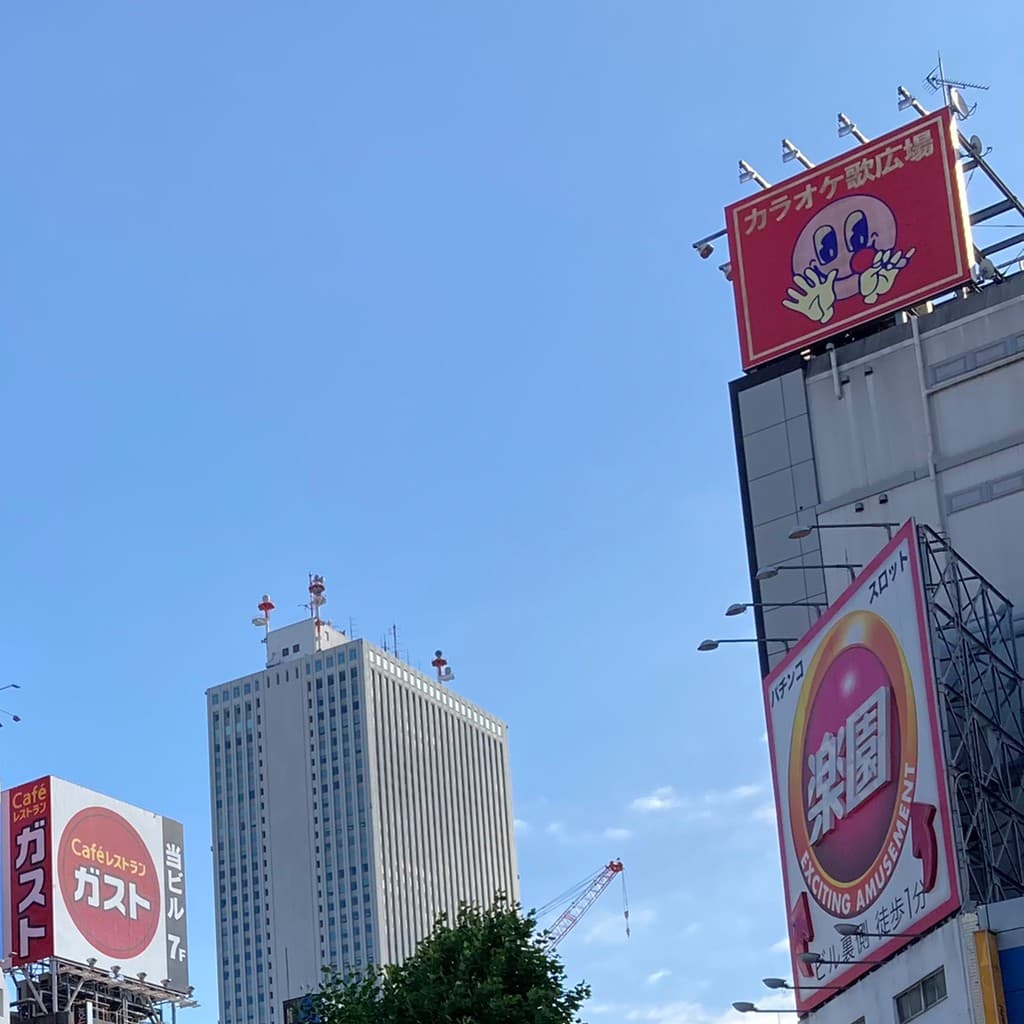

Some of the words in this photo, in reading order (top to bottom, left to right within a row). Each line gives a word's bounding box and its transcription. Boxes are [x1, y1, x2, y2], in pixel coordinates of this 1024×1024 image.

[743, 129, 935, 236] カラオケ歌広場
[868, 550, 908, 604] スロット
[771, 660, 804, 708] パチンコ
[807, 685, 894, 849] 楽園
[12, 783, 47, 811] Café
[13, 802, 47, 822] レストラン
[800, 850, 852, 916] EXCITING
[856, 762, 917, 912] AMUSEMENT
[15, 819, 47, 959] ガスト
[73, 866, 151, 921] ガスト
[165, 842, 184, 922] 当ビル
[167, 933, 186, 963] 7F
